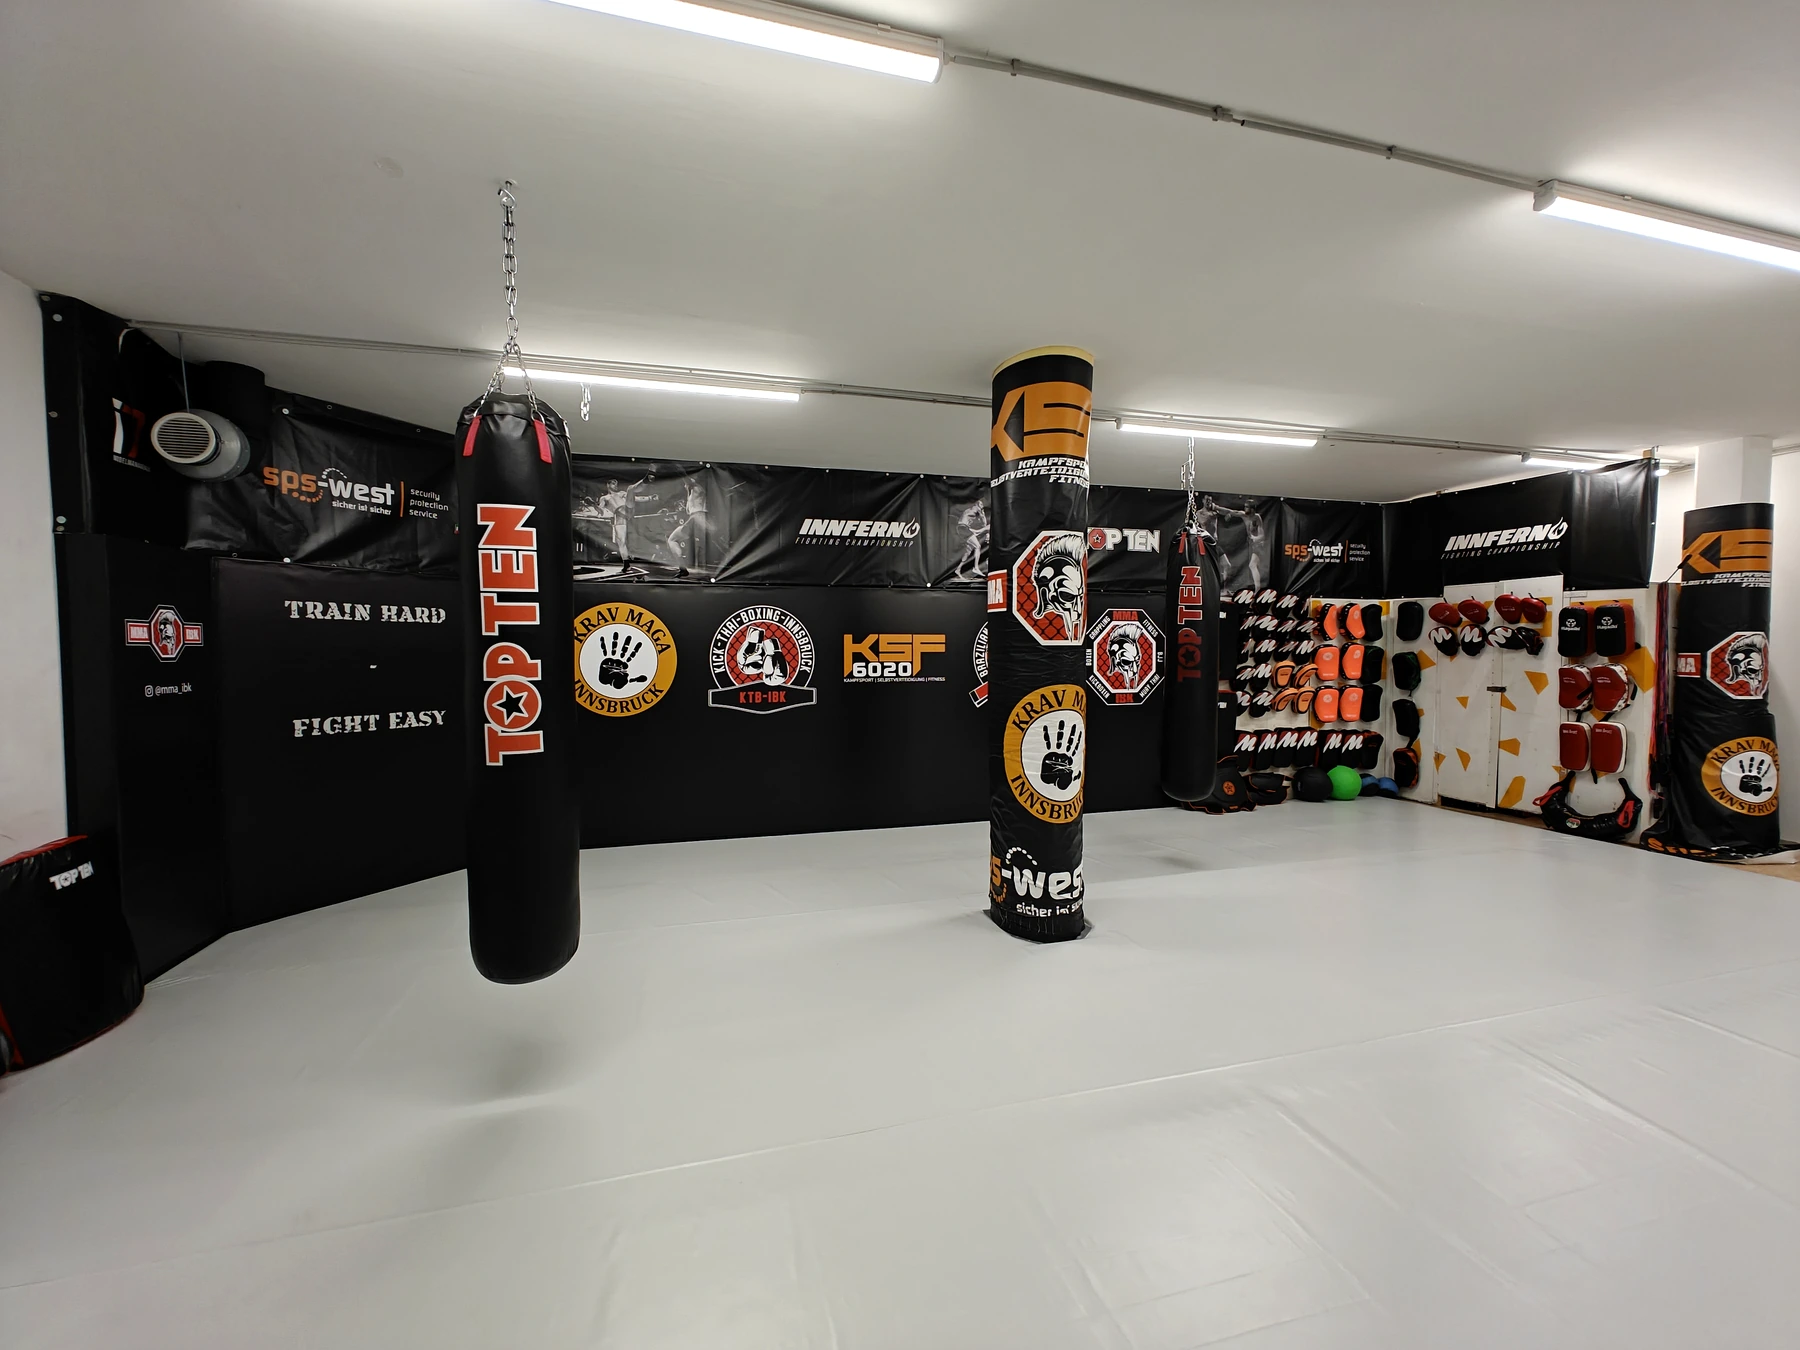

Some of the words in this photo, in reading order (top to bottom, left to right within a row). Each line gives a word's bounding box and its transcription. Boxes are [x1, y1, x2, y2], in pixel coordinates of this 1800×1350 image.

[263, 466, 394, 505] sps-west
[410, 488, 440, 501] security
[332, 500, 356, 510] sicher
[358, 504, 368, 512] ist
[370, 506, 392, 516] sicher
[409, 509, 438, 519] service
[410, 499, 449, 511] protection
[799, 518, 920, 538] INNFERNO
[1445, 517, 1568, 551] INNFERNO
[795, 537, 841, 546] FIGHTING
[846, 538, 914, 547] CHAMPIONSHIP
[1122, 528, 1160, 554] TEN
[1284, 543, 1344, 559] sps-west
[1441, 550, 1482, 559] FIGHTING
[1487, 541, 1561, 556] CHAMPIONSHIP
[477, 503, 540, 636] TEN
[1178, 566, 1202, 624] TEN
[284, 600, 371, 621] TRAIN
[381, 605, 446, 624] HARD
[1112, 611, 1138, 620] MMA
[575, 607, 619, 644] KRAV
[625, 608, 671, 655] MAGA
[843, 634, 946, 677] KSF
[852, 662, 912, 677] 6020
[155, 683, 192, 696] @mma_ibk
[575, 679, 664, 713] INNSBRUCK
[740, 691, 786, 703] KTB-IBK
[1115, 694, 1134, 703] IBK
[484, 642, 544, 766] TOP
[1012, 690, 1066, 733] KRAV
[292, 714, 380, 738] FIGHT
[388, 710, 447, 730] EASY
[1711, 740, 1755, 763] KRAV
[49, 867, 79, 890] TOP
[77, 861, 94, 880] TEN
[1016, 902, 1052, 917] sicher
